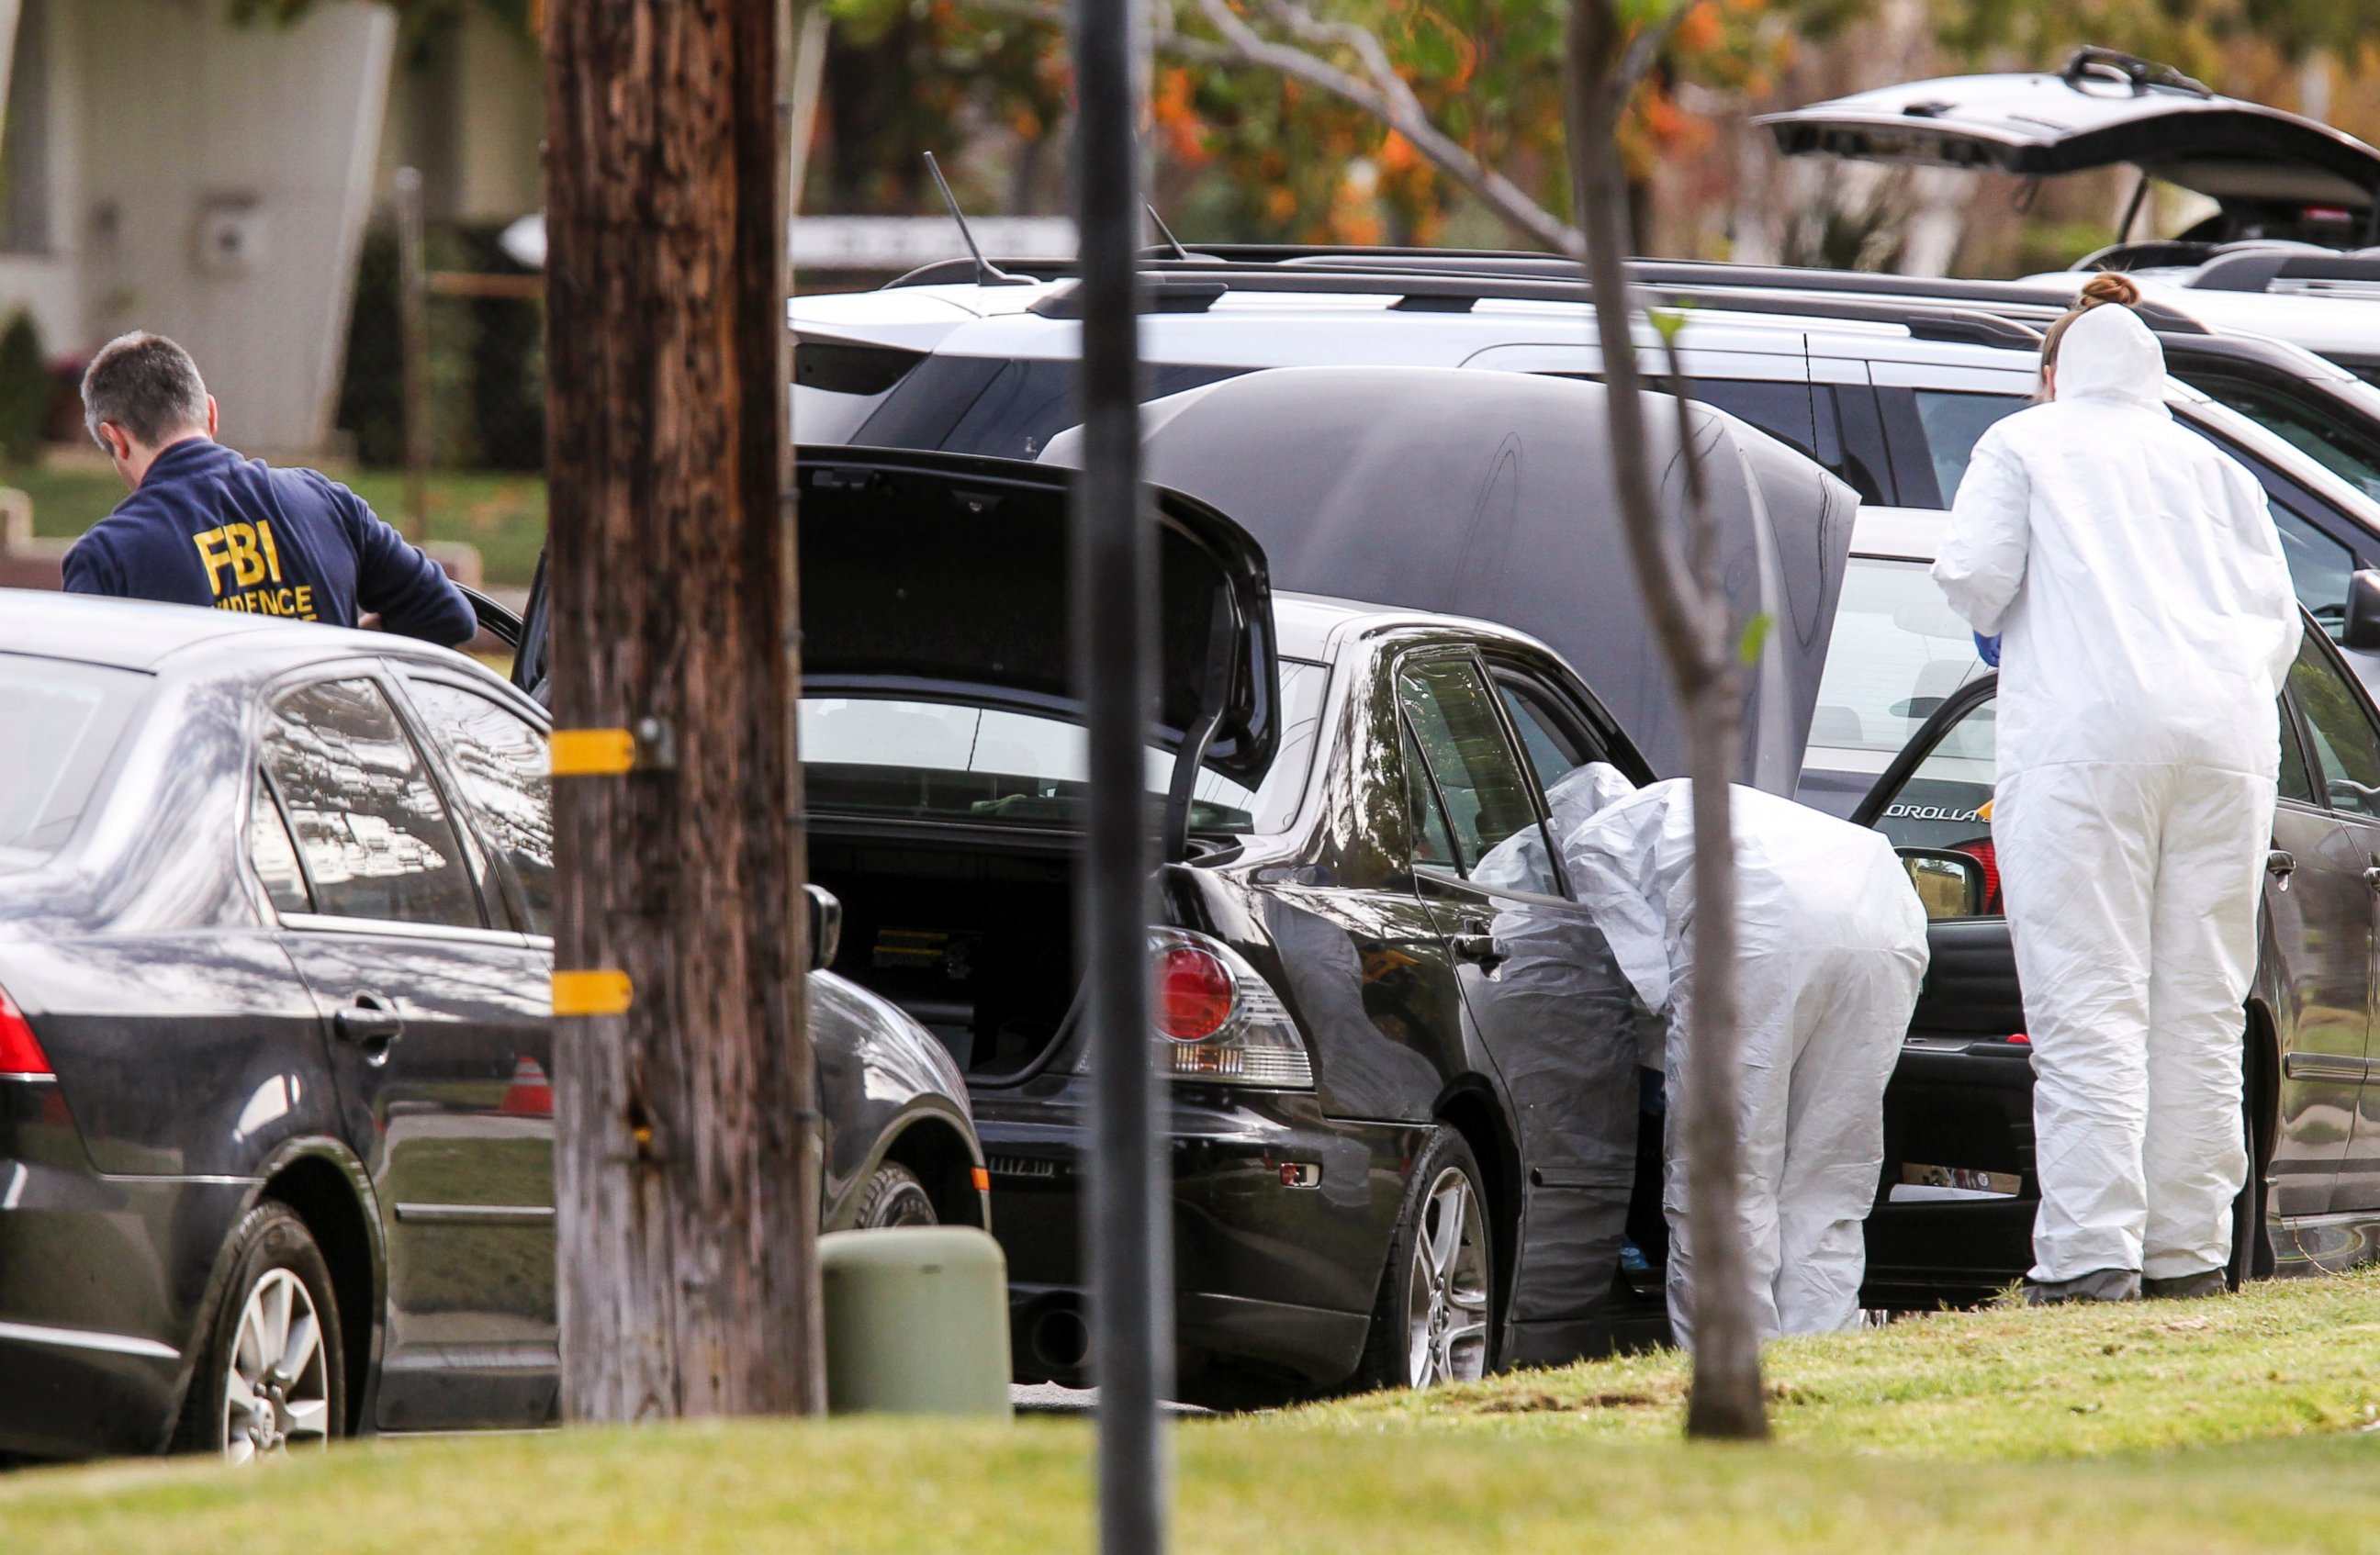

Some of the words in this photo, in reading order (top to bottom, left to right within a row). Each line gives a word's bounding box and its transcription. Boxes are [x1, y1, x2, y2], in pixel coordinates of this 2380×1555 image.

[193, 520, 282, 596] FBI
[212, 586, 312, 615] DENCE
[1882, 804, 1978, 822] OROLLA
